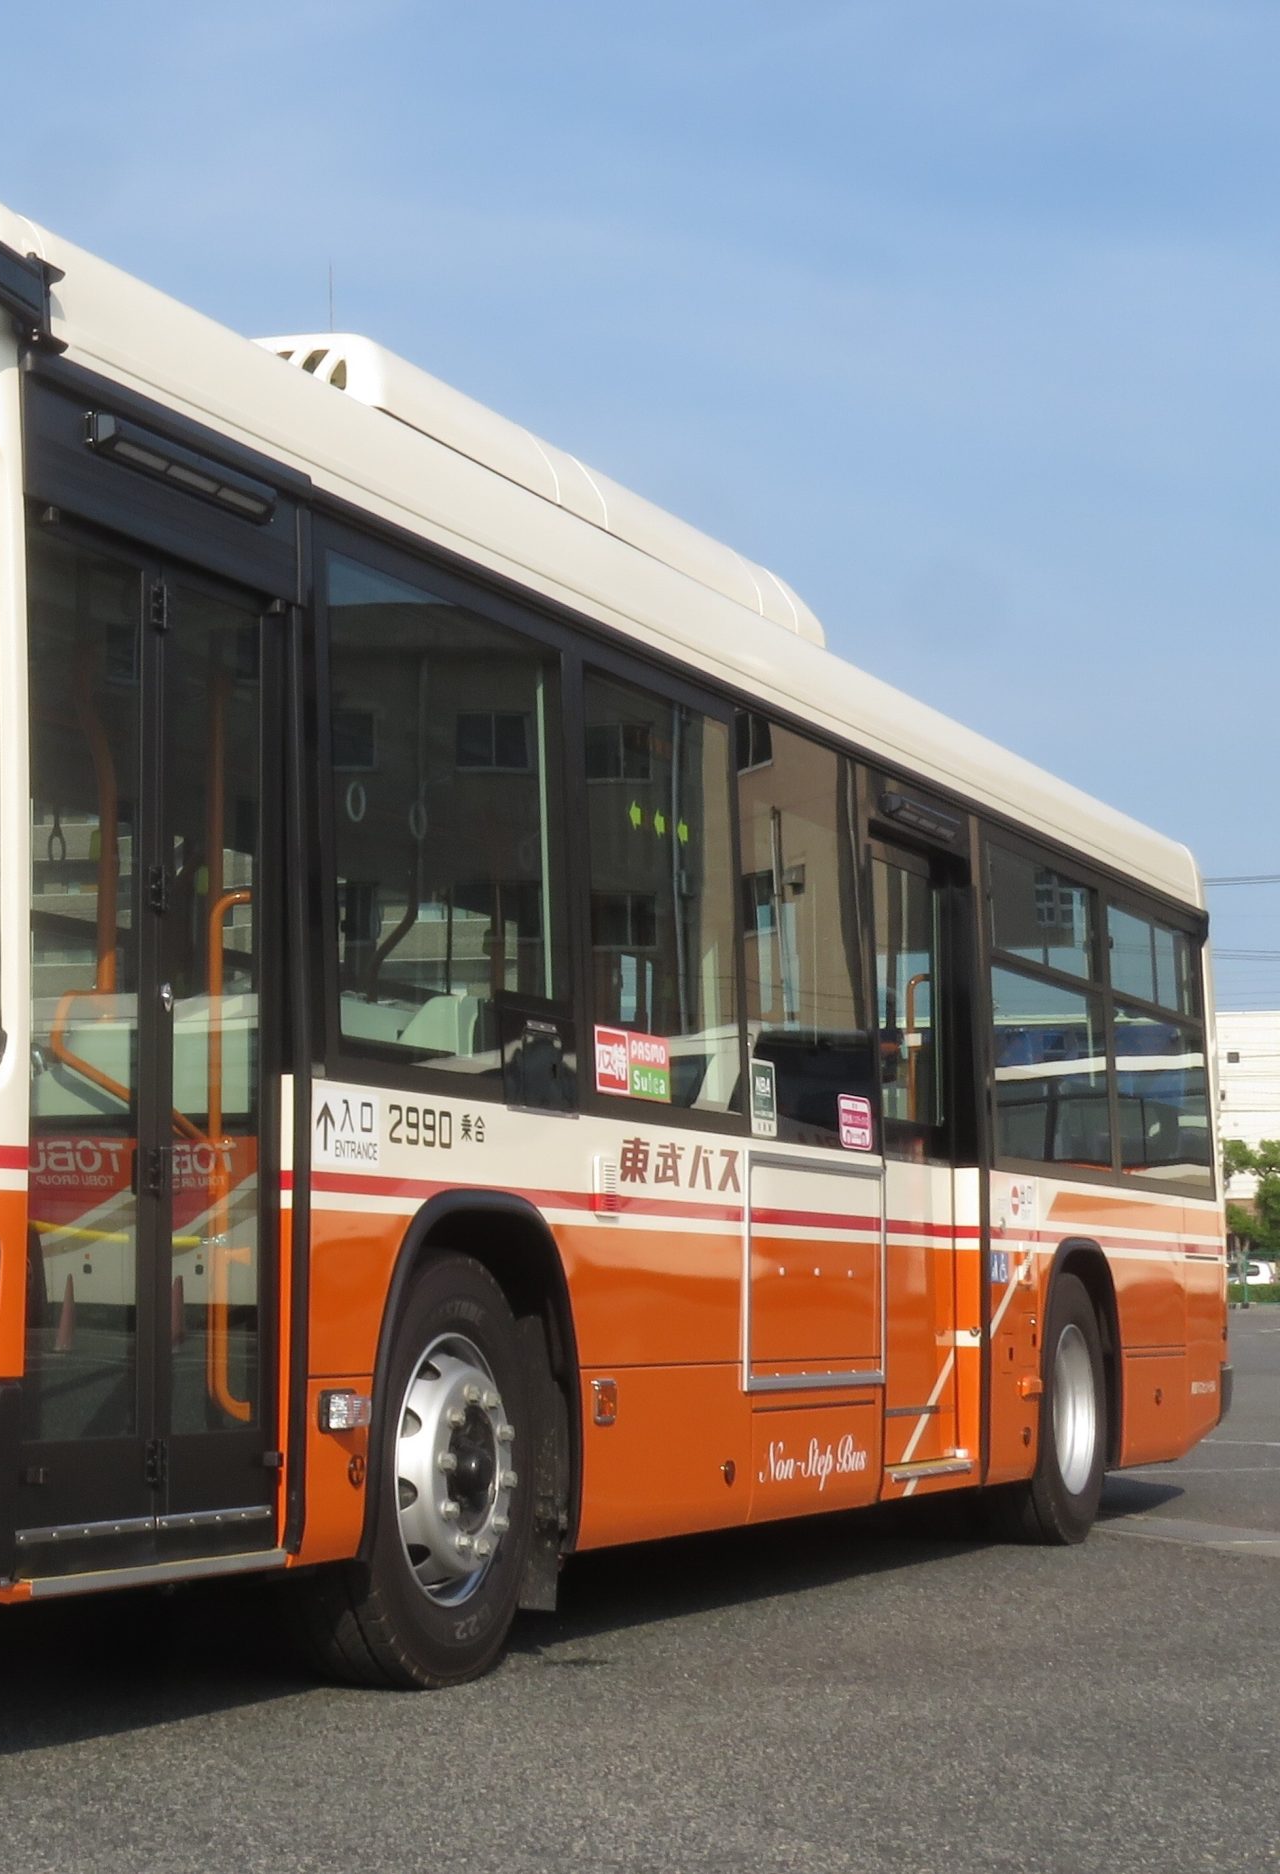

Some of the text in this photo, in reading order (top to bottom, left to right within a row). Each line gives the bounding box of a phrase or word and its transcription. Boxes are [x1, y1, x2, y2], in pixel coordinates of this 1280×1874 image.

[630, 1039, 666, 1065] PASMO
[633, 1069, 666, 1095] Suica
[340, 1099, 373, 1133] 入口
[388, 1104, 453, 1149] 2990
[460, 1114, 485, 1143] 乗合
[334, 1139, 378, 1161] ENTRANCE
[620, 1137, 741, 1193] 東武バス
[759, 1434, 867, 1492] Non-Step Bus
